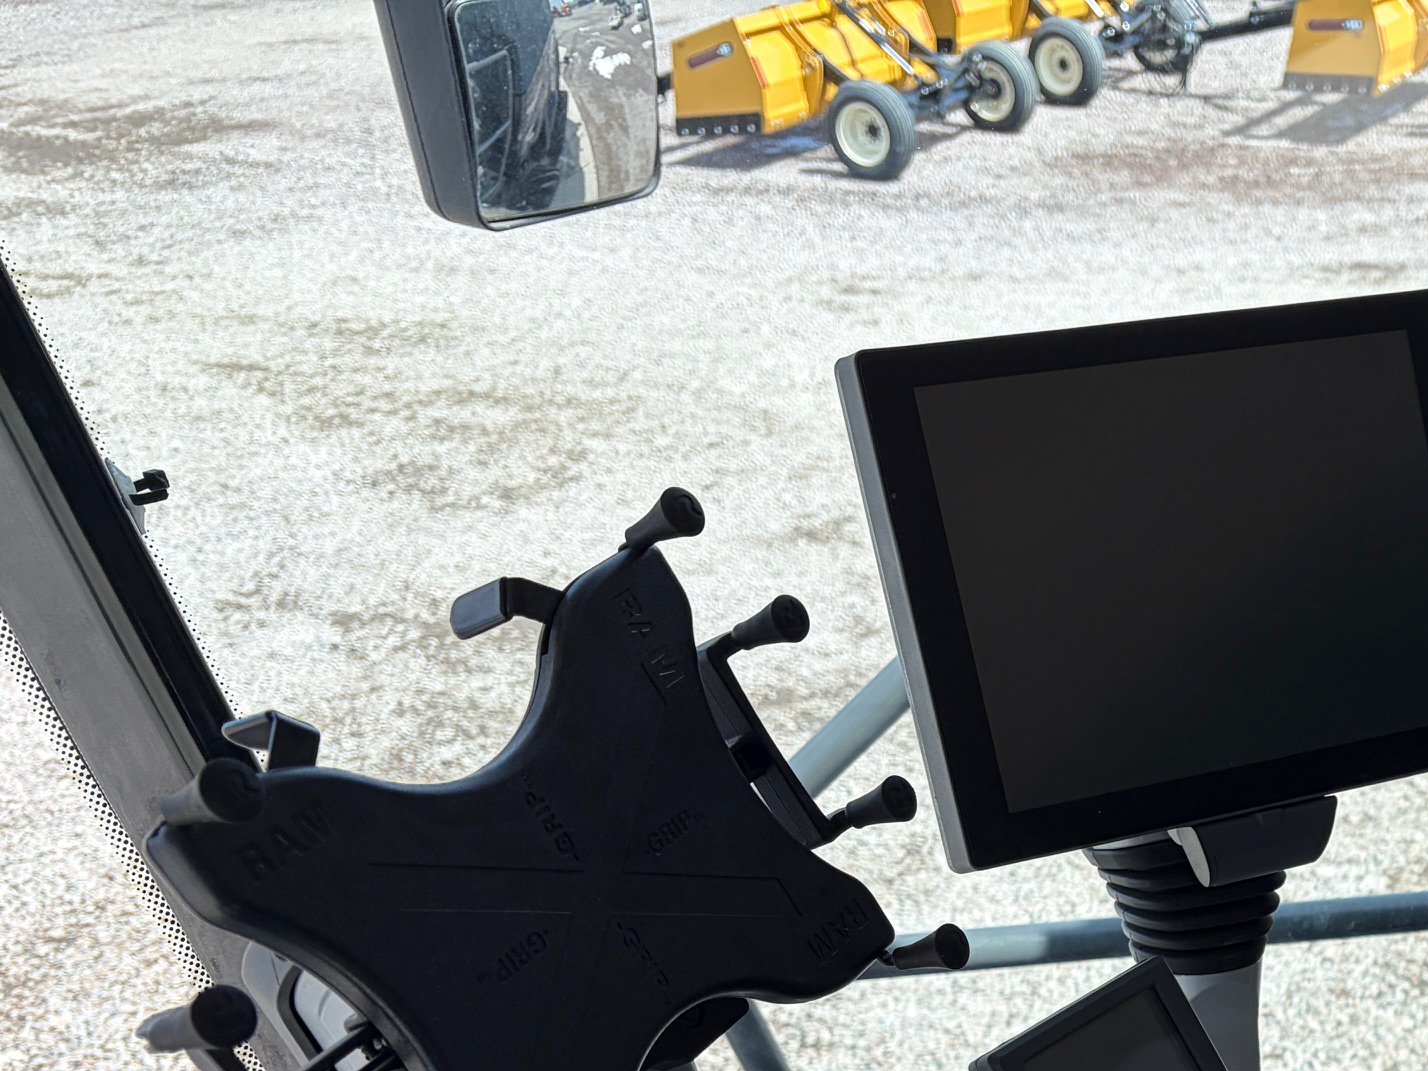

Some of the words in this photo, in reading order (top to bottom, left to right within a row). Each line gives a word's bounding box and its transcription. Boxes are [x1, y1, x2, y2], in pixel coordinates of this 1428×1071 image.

[612, 587, 685, 690] RAM
[236, 800, 338, 882] RAM
[805, 897, 871, 968] RAM
